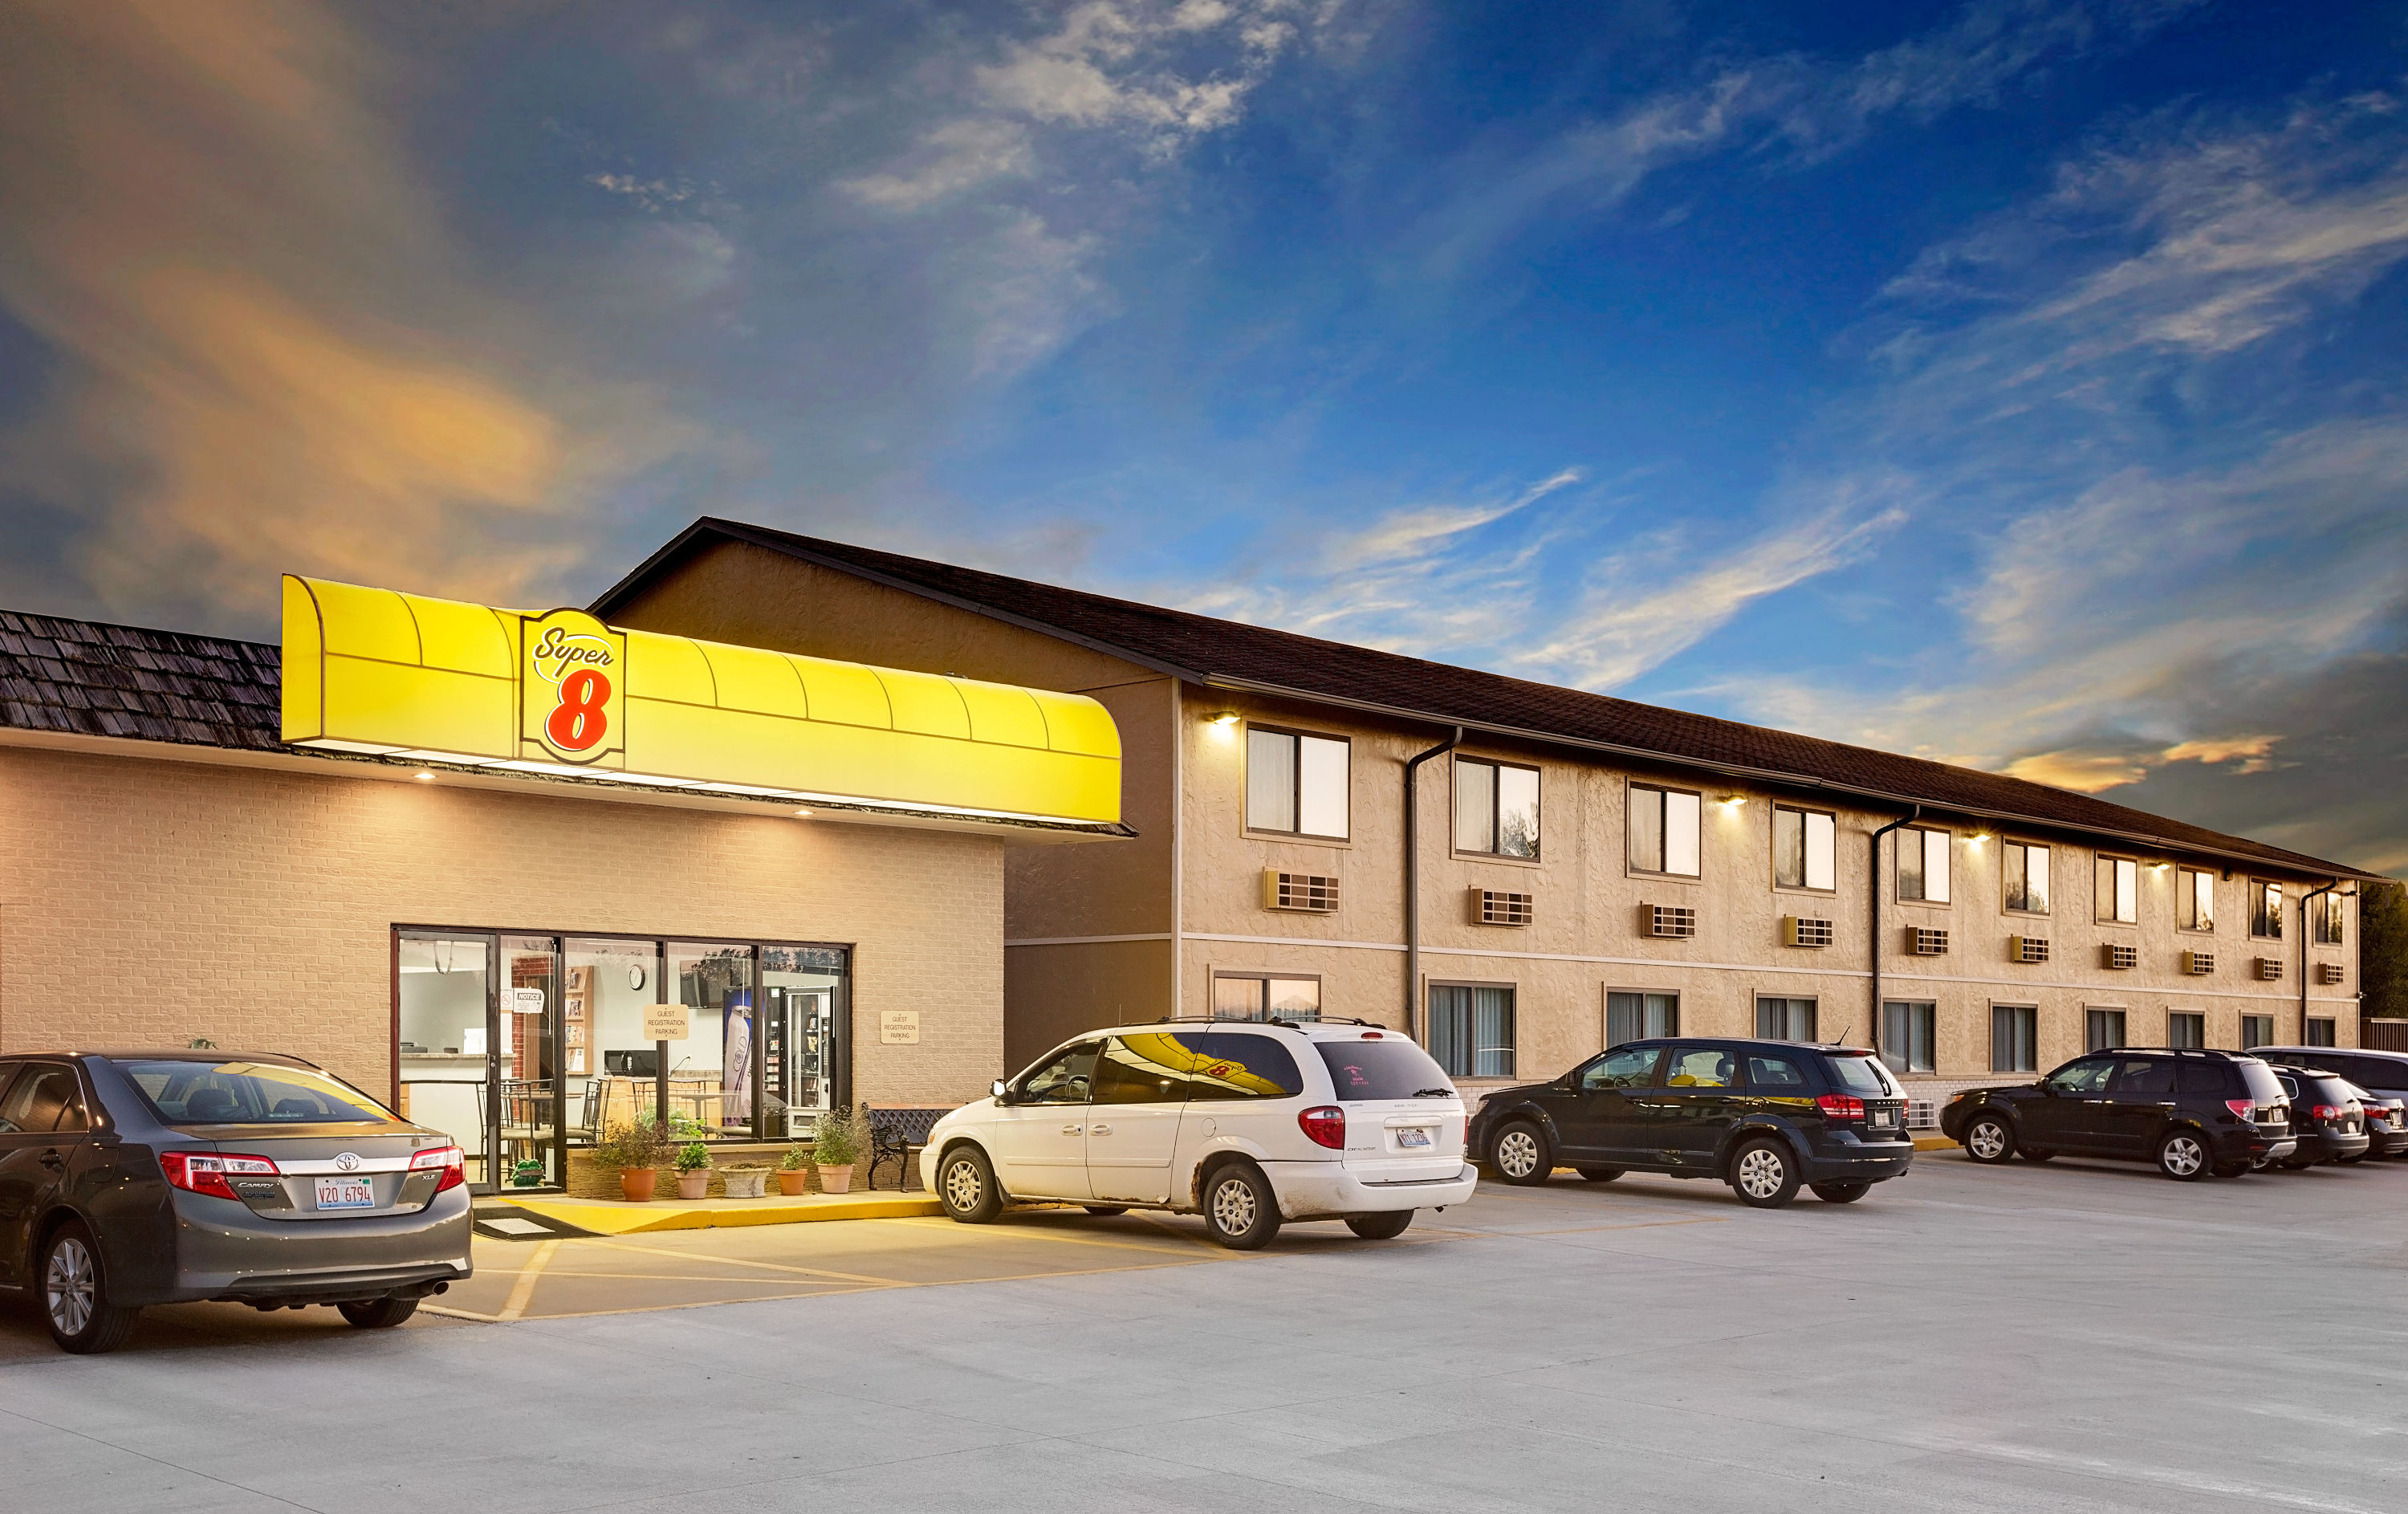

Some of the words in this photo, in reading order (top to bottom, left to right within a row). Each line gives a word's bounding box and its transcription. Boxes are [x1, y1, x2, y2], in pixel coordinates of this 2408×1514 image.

[532, 627, 614, 678] Super
[544, 669, 612, 751] 8
[733, 1036, 747, 1072] COLD
[319, 1187, 339, 1203] V20
[345, 1186, 371, 1203] 6794
